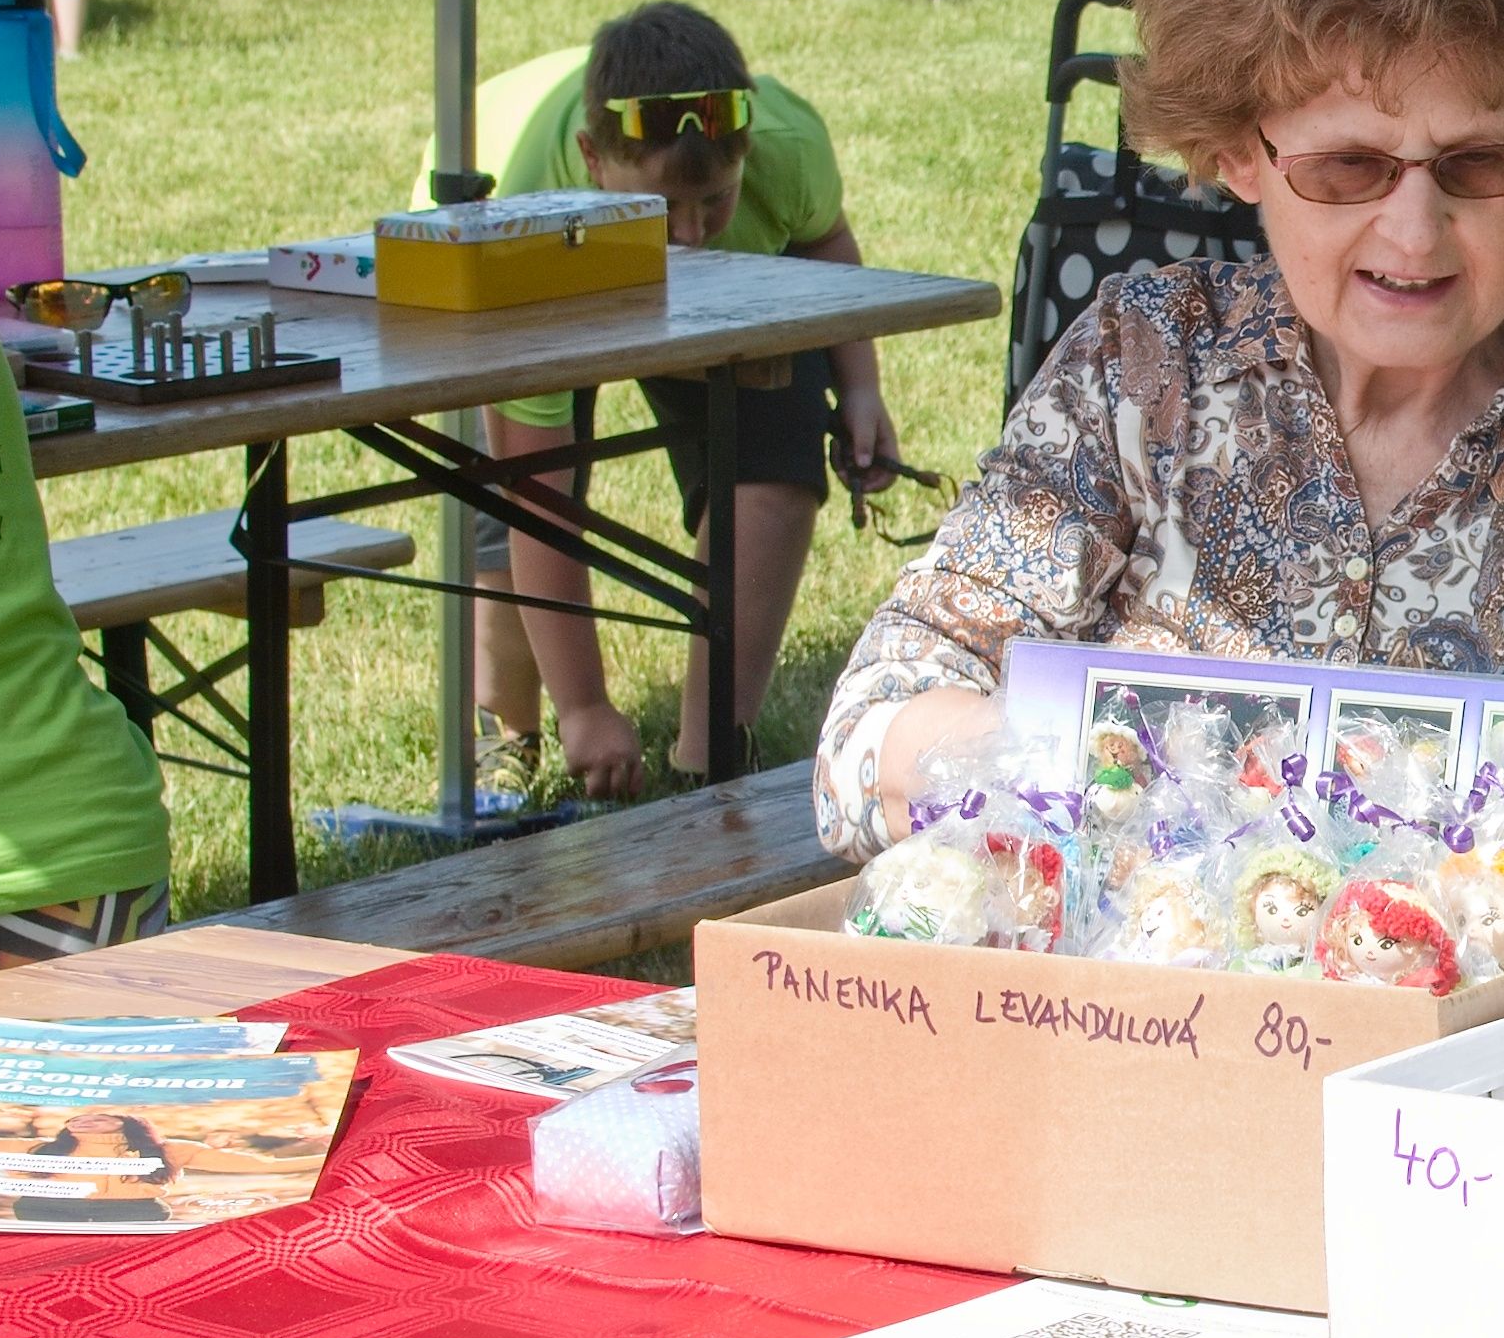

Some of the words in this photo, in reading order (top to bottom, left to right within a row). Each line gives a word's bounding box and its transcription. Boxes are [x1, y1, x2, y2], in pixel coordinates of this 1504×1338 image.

[753, 950, 937, 1035] PANENKA
[976, 989, 1204, 1058] LEVANDULOVÁ
[1253, 1002, 1332, 1070] 80,-
